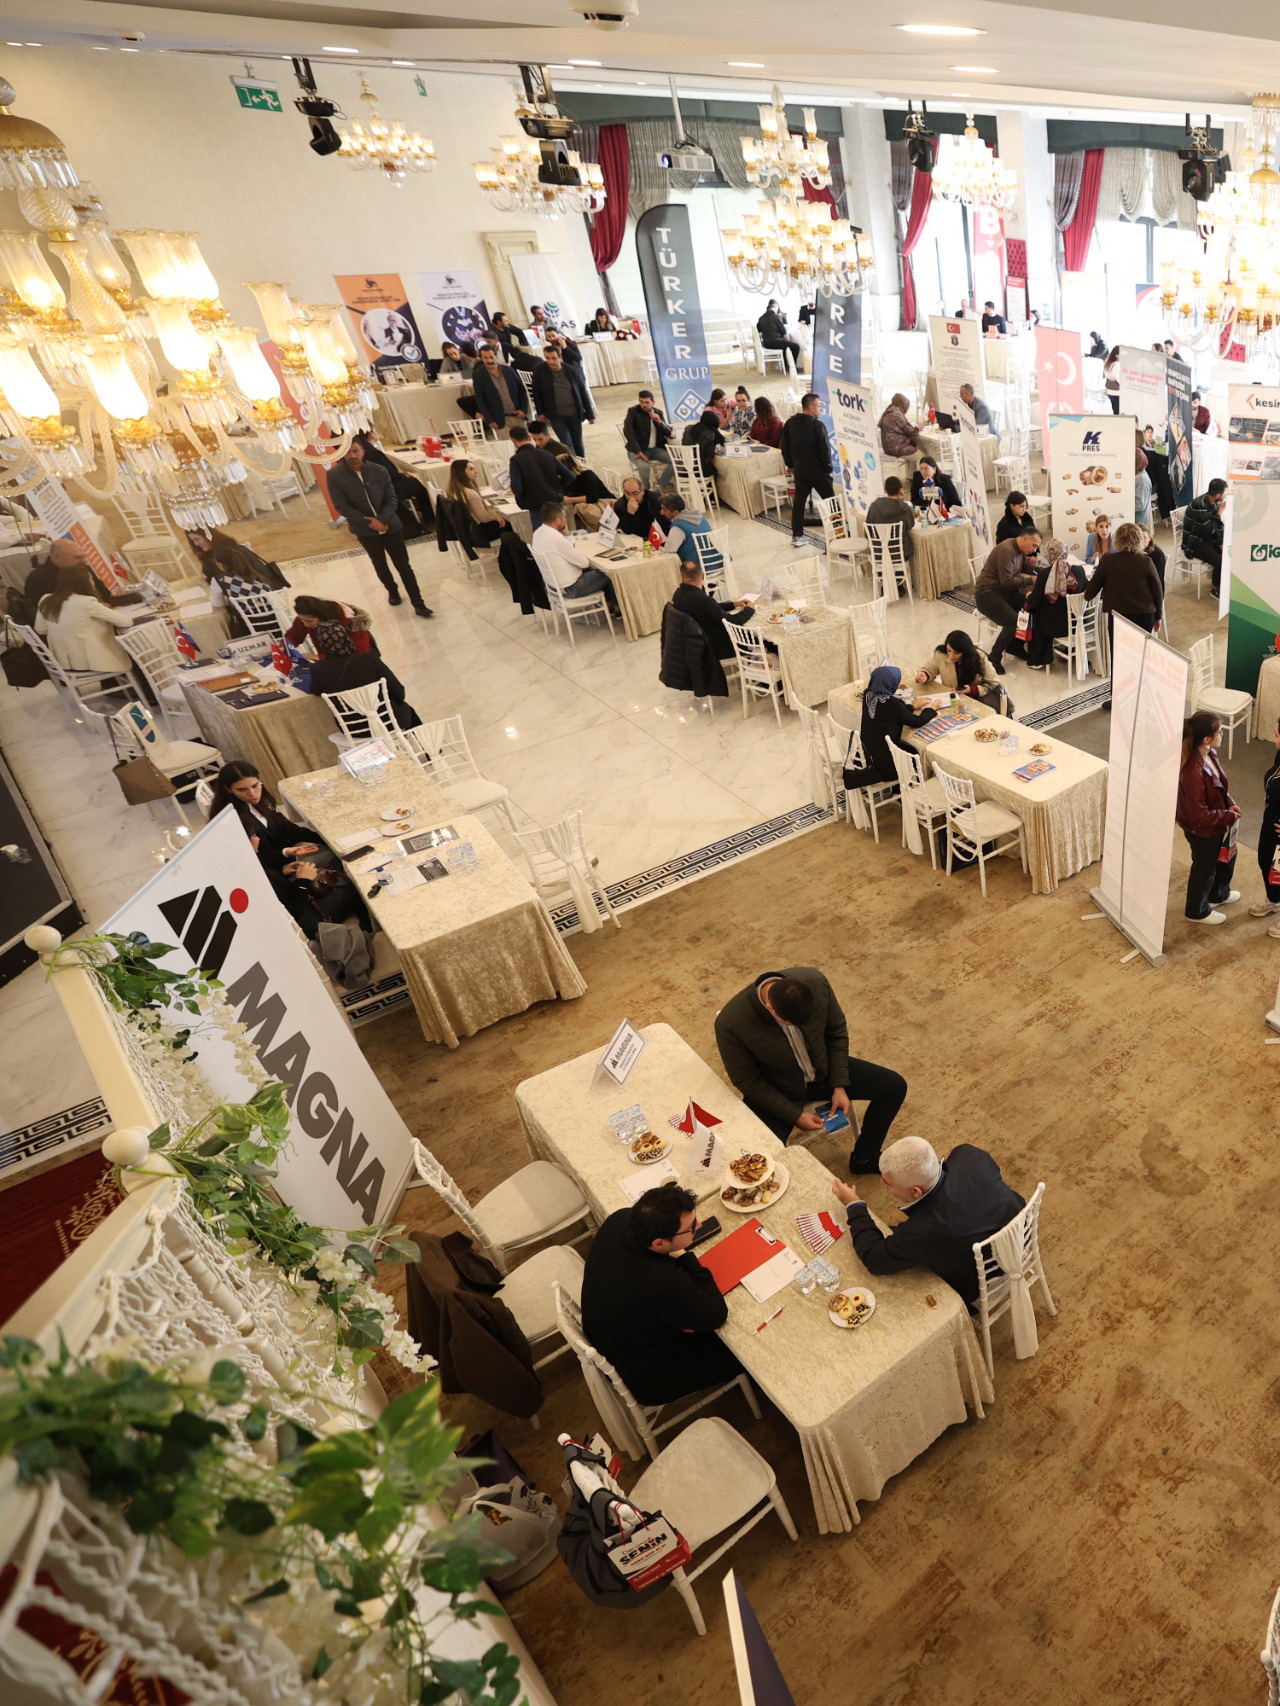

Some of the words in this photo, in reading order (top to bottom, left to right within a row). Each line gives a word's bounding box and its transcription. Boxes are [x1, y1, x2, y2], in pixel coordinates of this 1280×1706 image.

[656, 227, 693, 360] TÜRKER
[664, 366, 709, 381] GRUP
[837, 388, 866, 412] tork
[237, 641, 267, 653] UZMAR
[614, 1032, 633, 1060] MAGNA
[226, 961, 387, 1226] MAGNA
